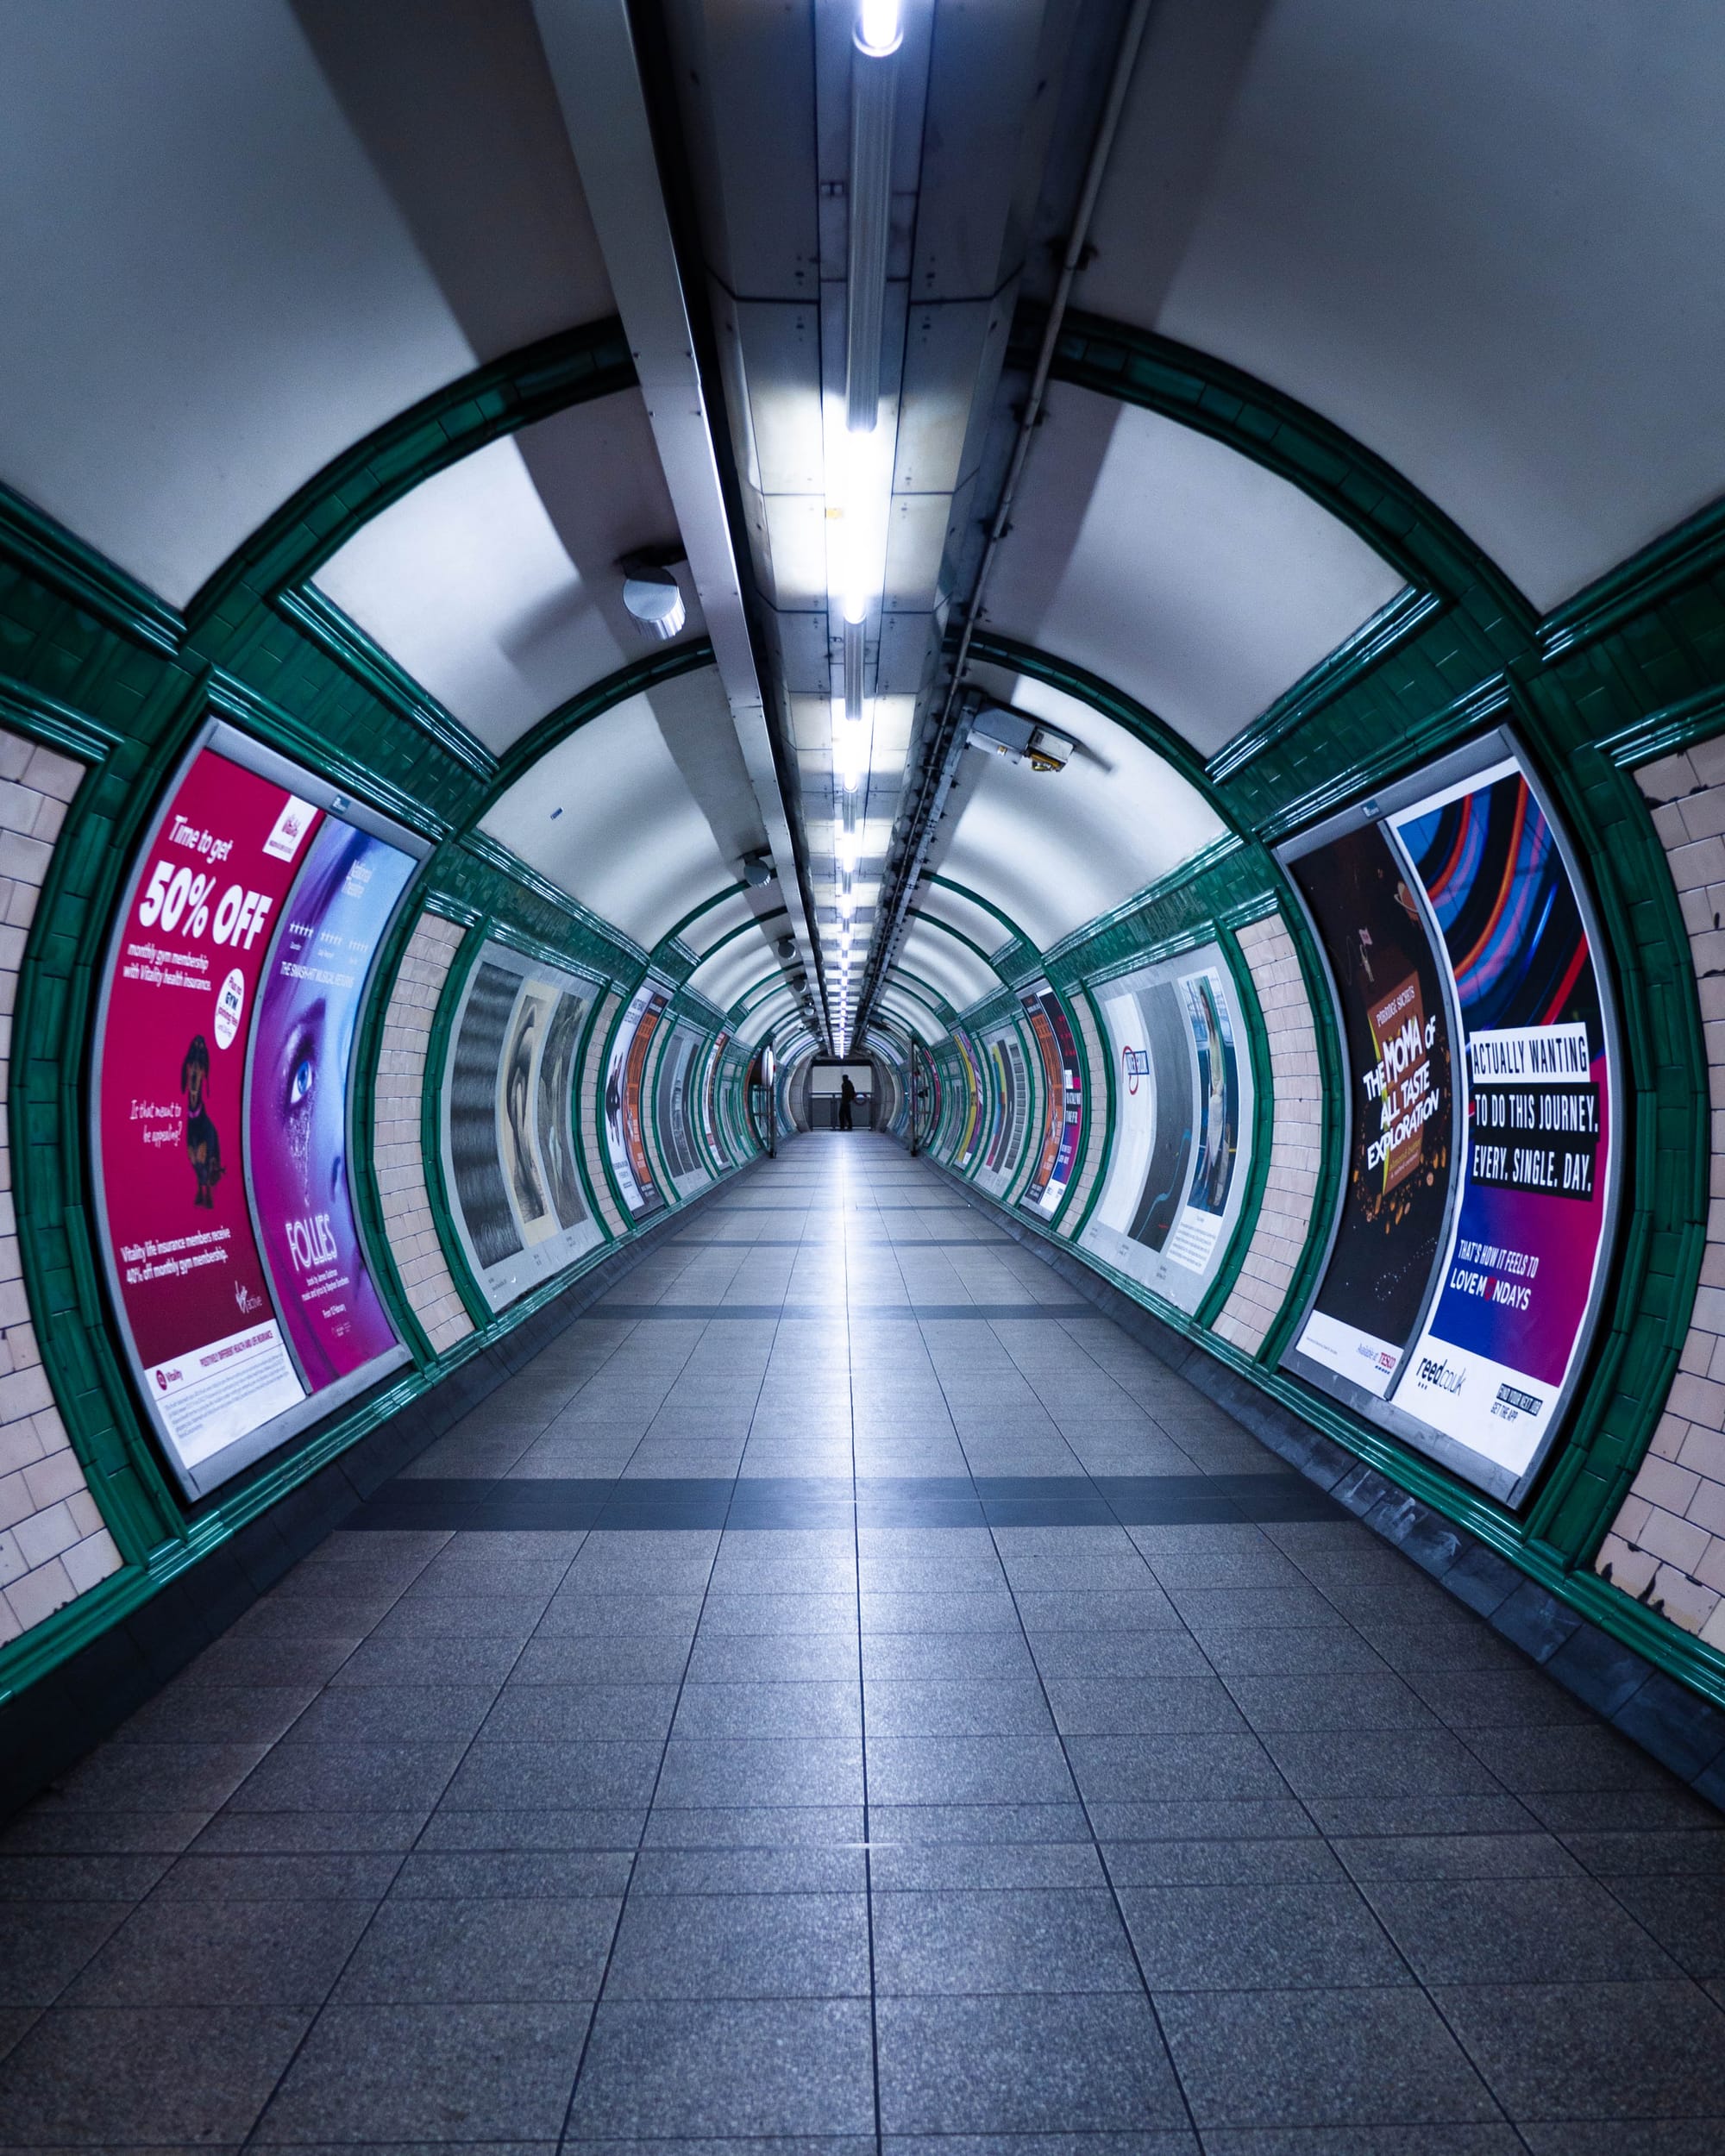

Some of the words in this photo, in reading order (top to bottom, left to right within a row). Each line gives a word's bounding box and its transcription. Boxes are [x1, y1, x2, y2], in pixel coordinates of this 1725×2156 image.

[168, 814, 200, 849] Time
[197, 830, 213, 854] to
[206, 840, 234, 864] get
[139, 860, 216, 938] 50%
[212, 884, 273, 950] OFF
[122, 962, 140, 979] with
[140, 964, 164, 987] Vitality
[163, 968, 183, 987] health
[128, 943, 155, 964] monthly
[154, 950, 172, 966] gym
[172, 951, 210, 974] membership
[1363, 1061, 1387, 1101] THE
[1383, 1015, 1422, 1083] MOMA
[1425, 1015, 1436, 1050] OF
[1473, 1040, 1525, 1075] ACTUALLY
[1528, 1036, 1588, 1074] WANTING
[139, 1100, 154, 1119] that
[174, 1103, 182, 1118] to
[1380, 1091, 1401, 1130] ALL
[1401, 1060, 1430, 1109] TASTE
[1474, 1094, 1488, 1126] TO
[1491, 1094, 1506, 1128] DO
[1509, 1094, 1535, 1130] THIS
[1539, 1094, 1599, 1132] JOURNEY.
[143, 1124, 152, 1143] be
[1367, 1088, 1440, 1170] EXPLORATION
[1472, 1144, 1509, 1181] EVERY.
[1512, 1148, 1558, 1188] SINGLE.
[1563, 1152, 1592, 1192] DAY.
[120, 1244, 146, 1263] Vitality
[144, 1240, 157, 1257] life
[156, 1238, 185, 1255] insurance
[185, 1230, 212, 1249] members
[211, 1225, 231, 1241] receive
[285, 1213, 338, 1272] FOLLIES
[1458, 1239, 1483, 1263] THAT'S
[1479, 1244, 1500, 1268] HOW
[1496, 1249, 1508, 1269] IT
[1504, 1250, 1529, 1275] FEELS
[1527, 1256, 1540, 1279] TO
[126, 1267, 144, 1284] 40%
[142, 1262, 154, 1280] off
[153, 1257, 179, 1276] monthly
[179, 1257, 194, 1275] gym
[1450, 1267, 1479, 1294] LOVE
[1377, 1351, 1396, 1369] TESCO
[1520, 1395, 1534, 1410] NEXT
